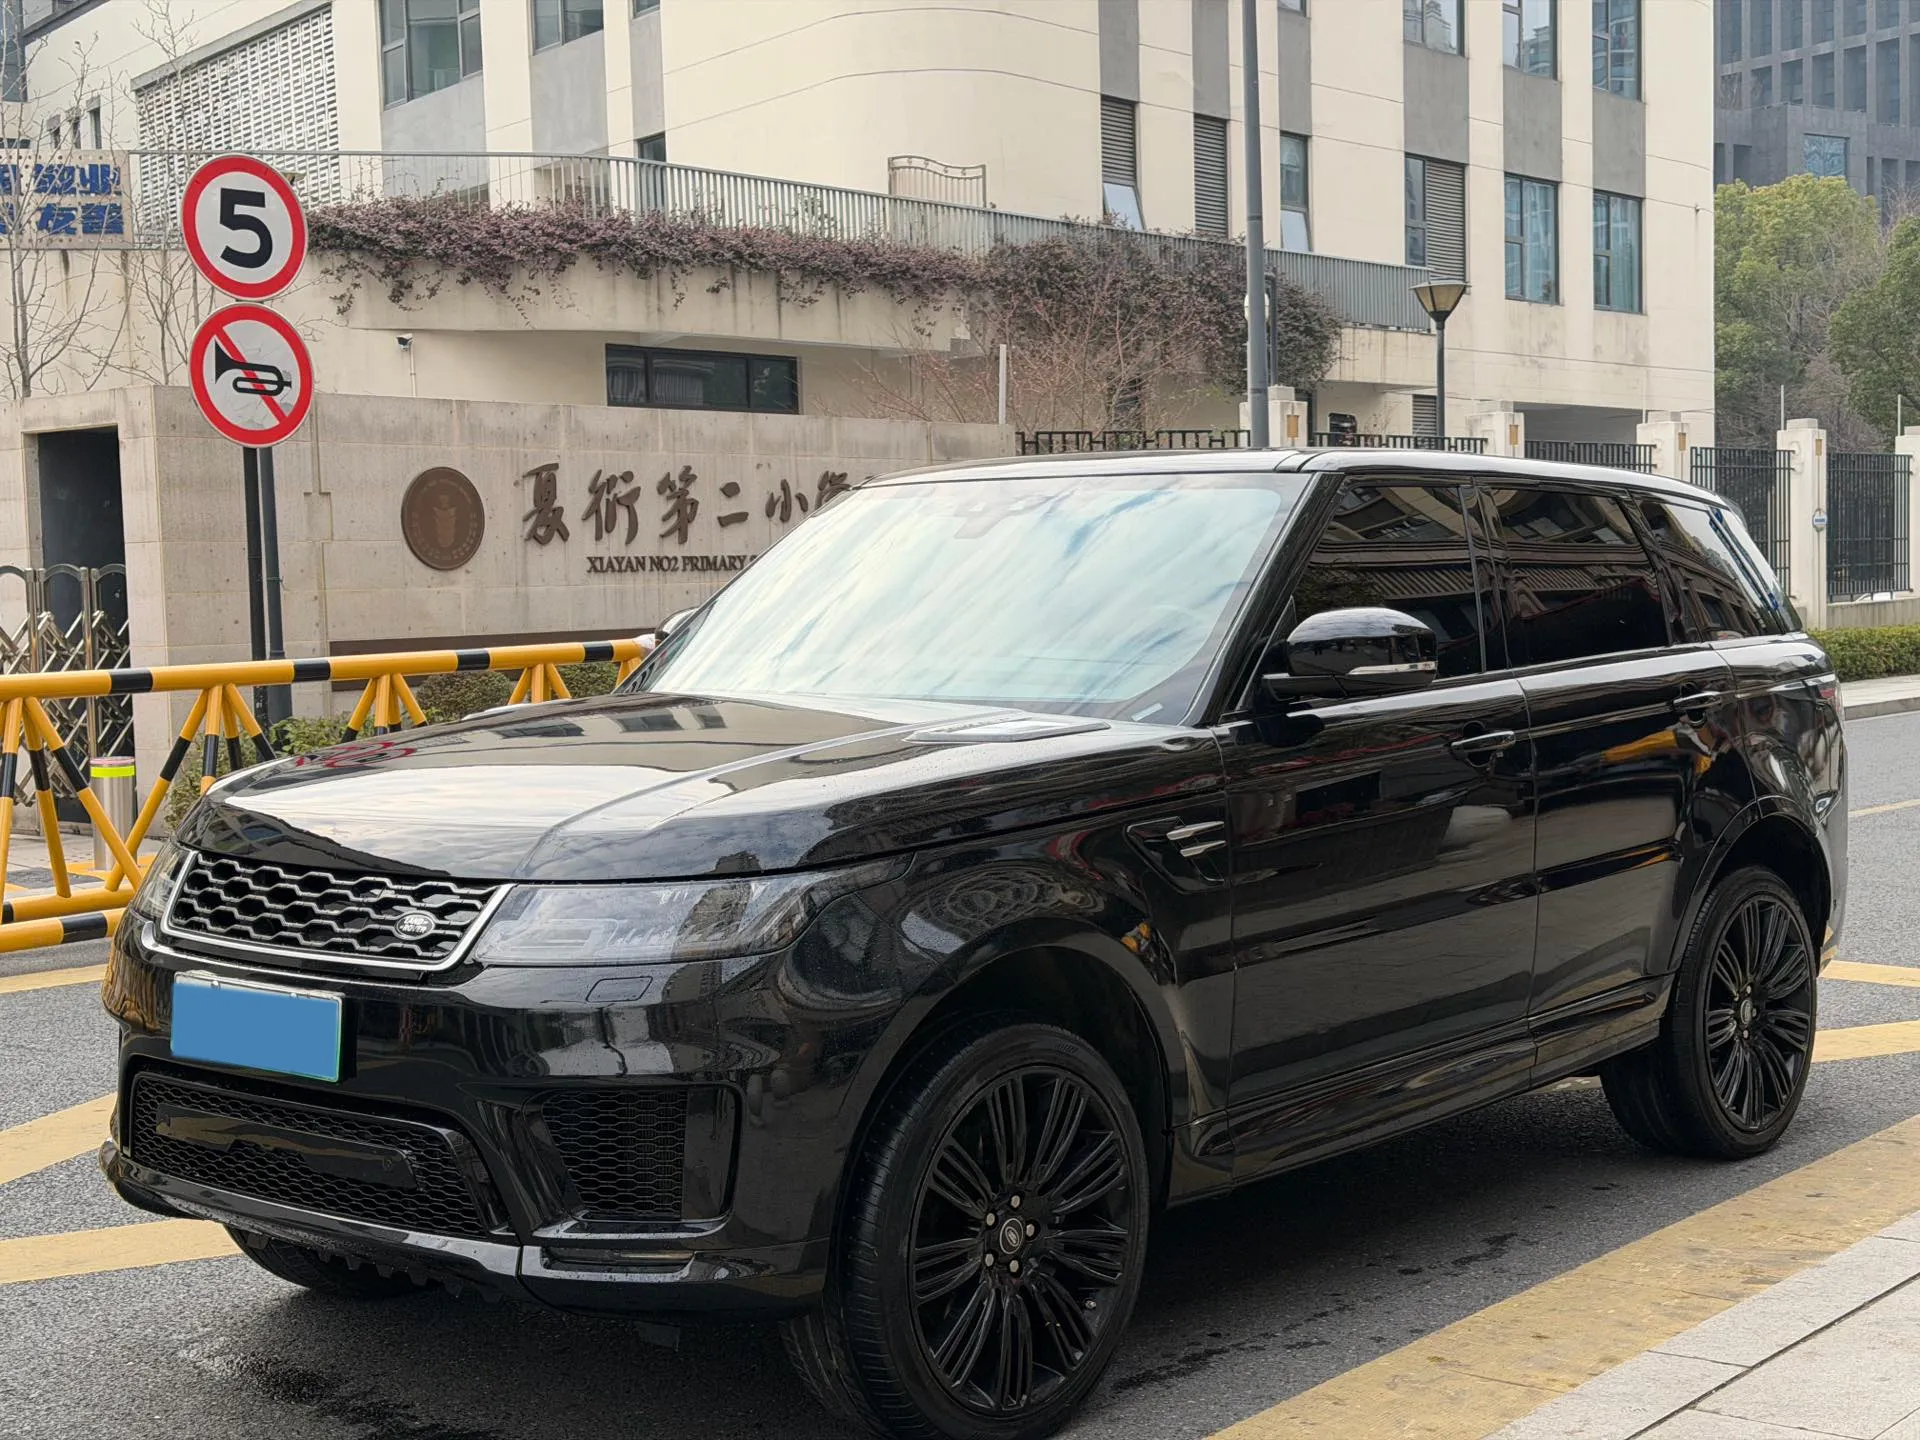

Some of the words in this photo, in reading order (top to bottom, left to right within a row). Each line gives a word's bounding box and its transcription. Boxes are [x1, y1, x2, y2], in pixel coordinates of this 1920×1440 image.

[219, 187, 273, 269] 5
[587, 556, 645, 573] XIAYAN
[682, 555, 747, 571] PRIMARY
[403, 917, 425, 925] LAND
[402, 924, 427, 933] ROVER
